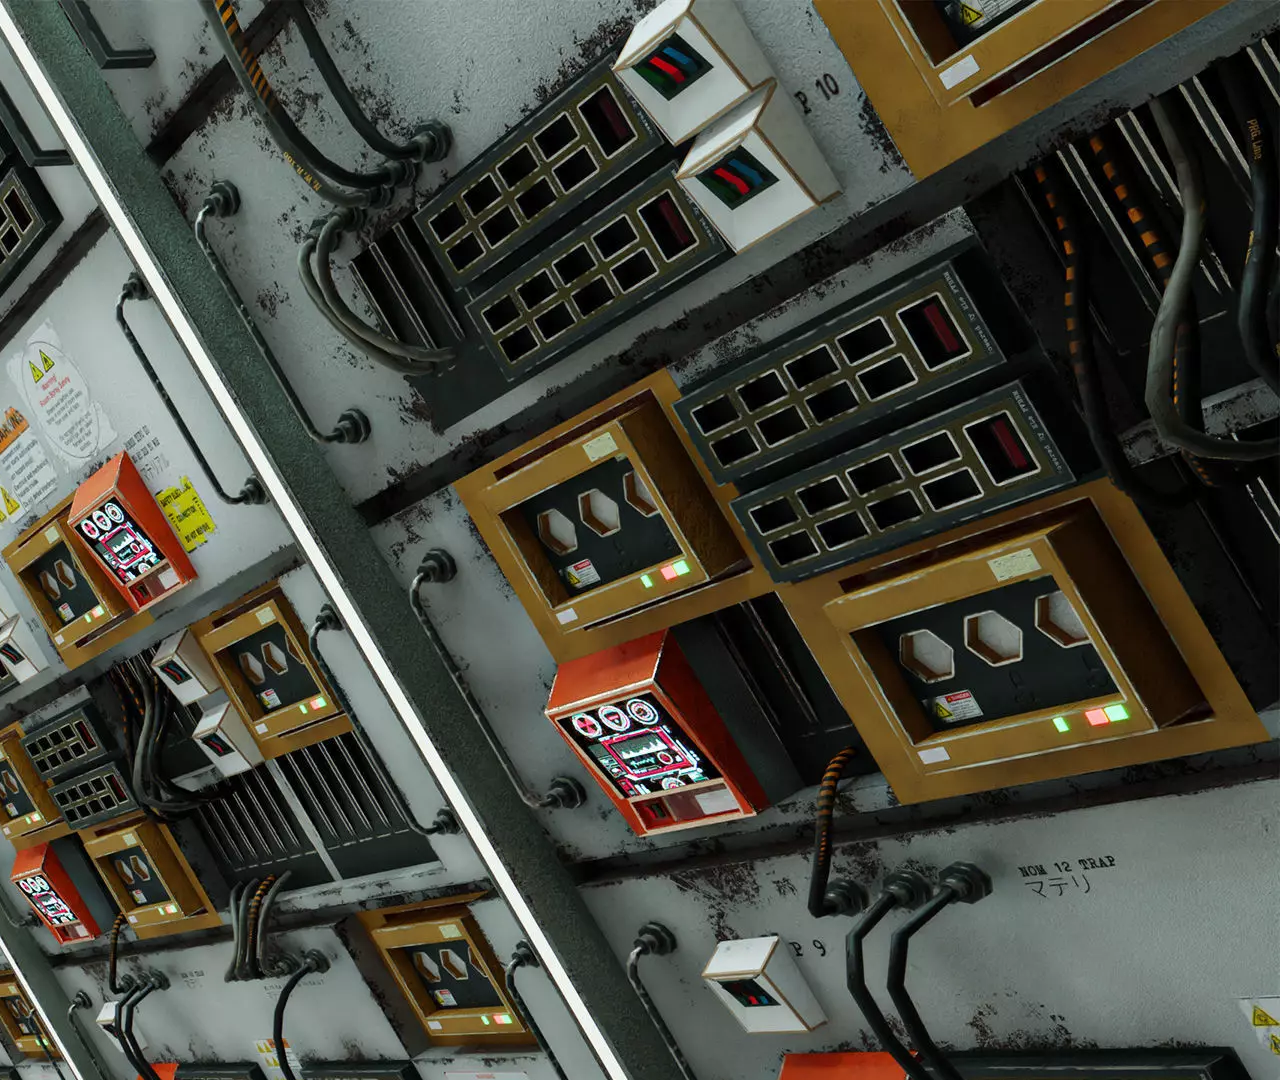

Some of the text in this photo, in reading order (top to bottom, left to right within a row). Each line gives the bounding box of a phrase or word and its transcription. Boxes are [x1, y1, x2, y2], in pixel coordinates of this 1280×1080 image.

[795, 73, 839, 116] P 10
[1018, 855, 1116, 877] NOM 12 TRAP
[1024, 874, 1091, 898] マテリ
[789, 939, 826, 957] P 9
